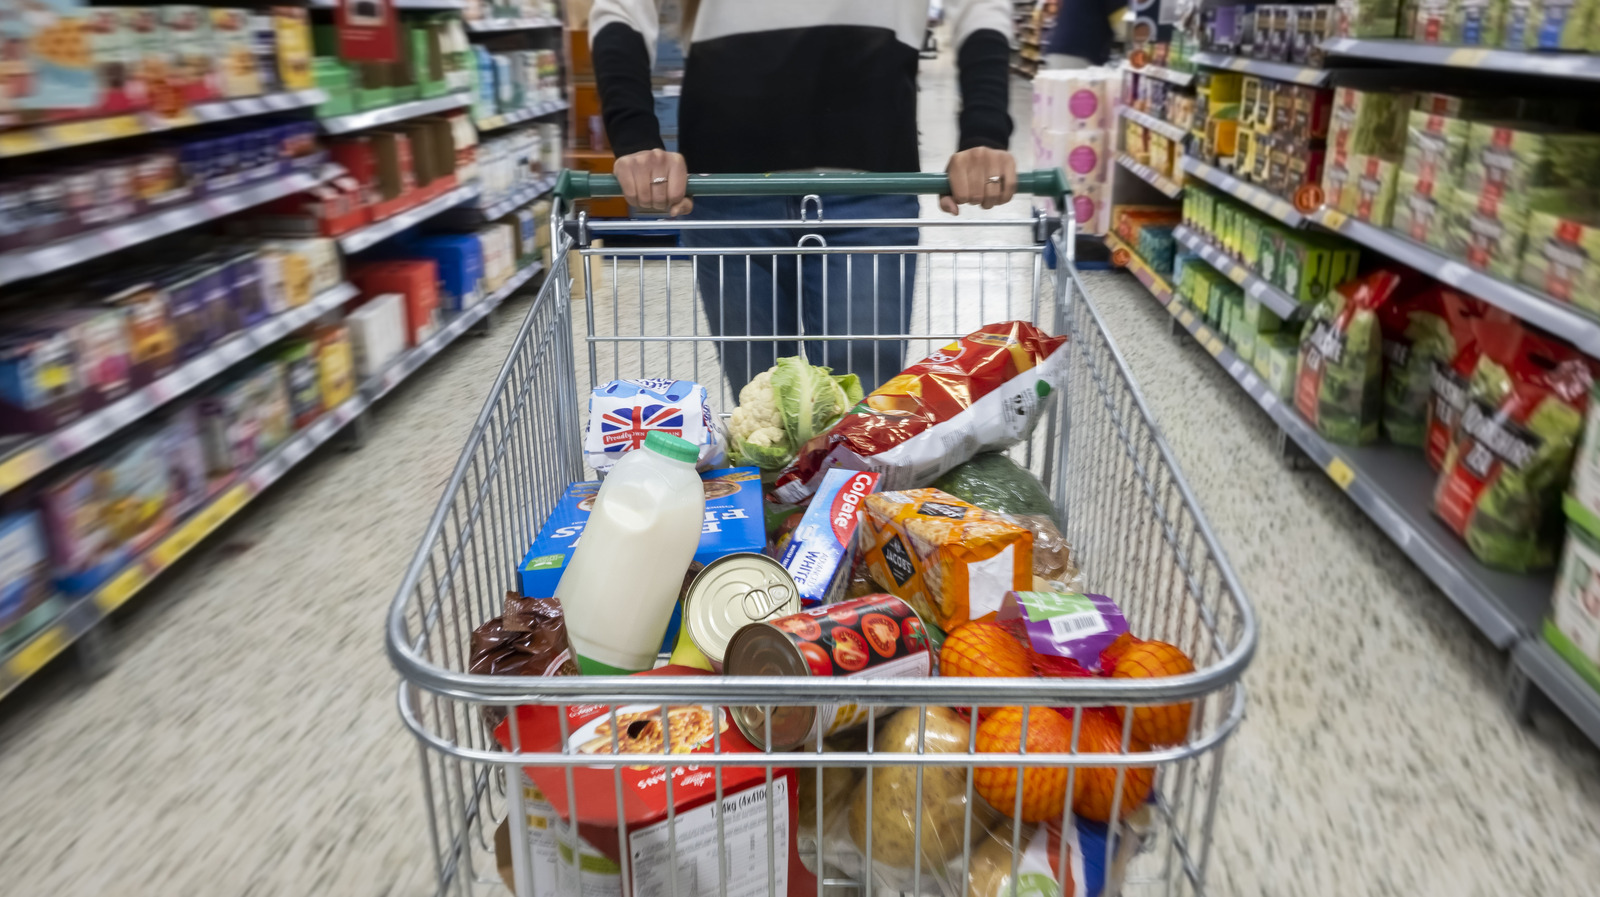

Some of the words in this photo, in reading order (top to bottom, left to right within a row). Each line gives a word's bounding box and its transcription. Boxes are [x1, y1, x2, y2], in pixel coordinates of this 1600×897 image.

[606, 431, 633, 443] Proudly
[834, 473, 872, 529] Colgate
[794, 551, 820, 584] WHITE
[886, 547, 912, 574] JACOB'S
